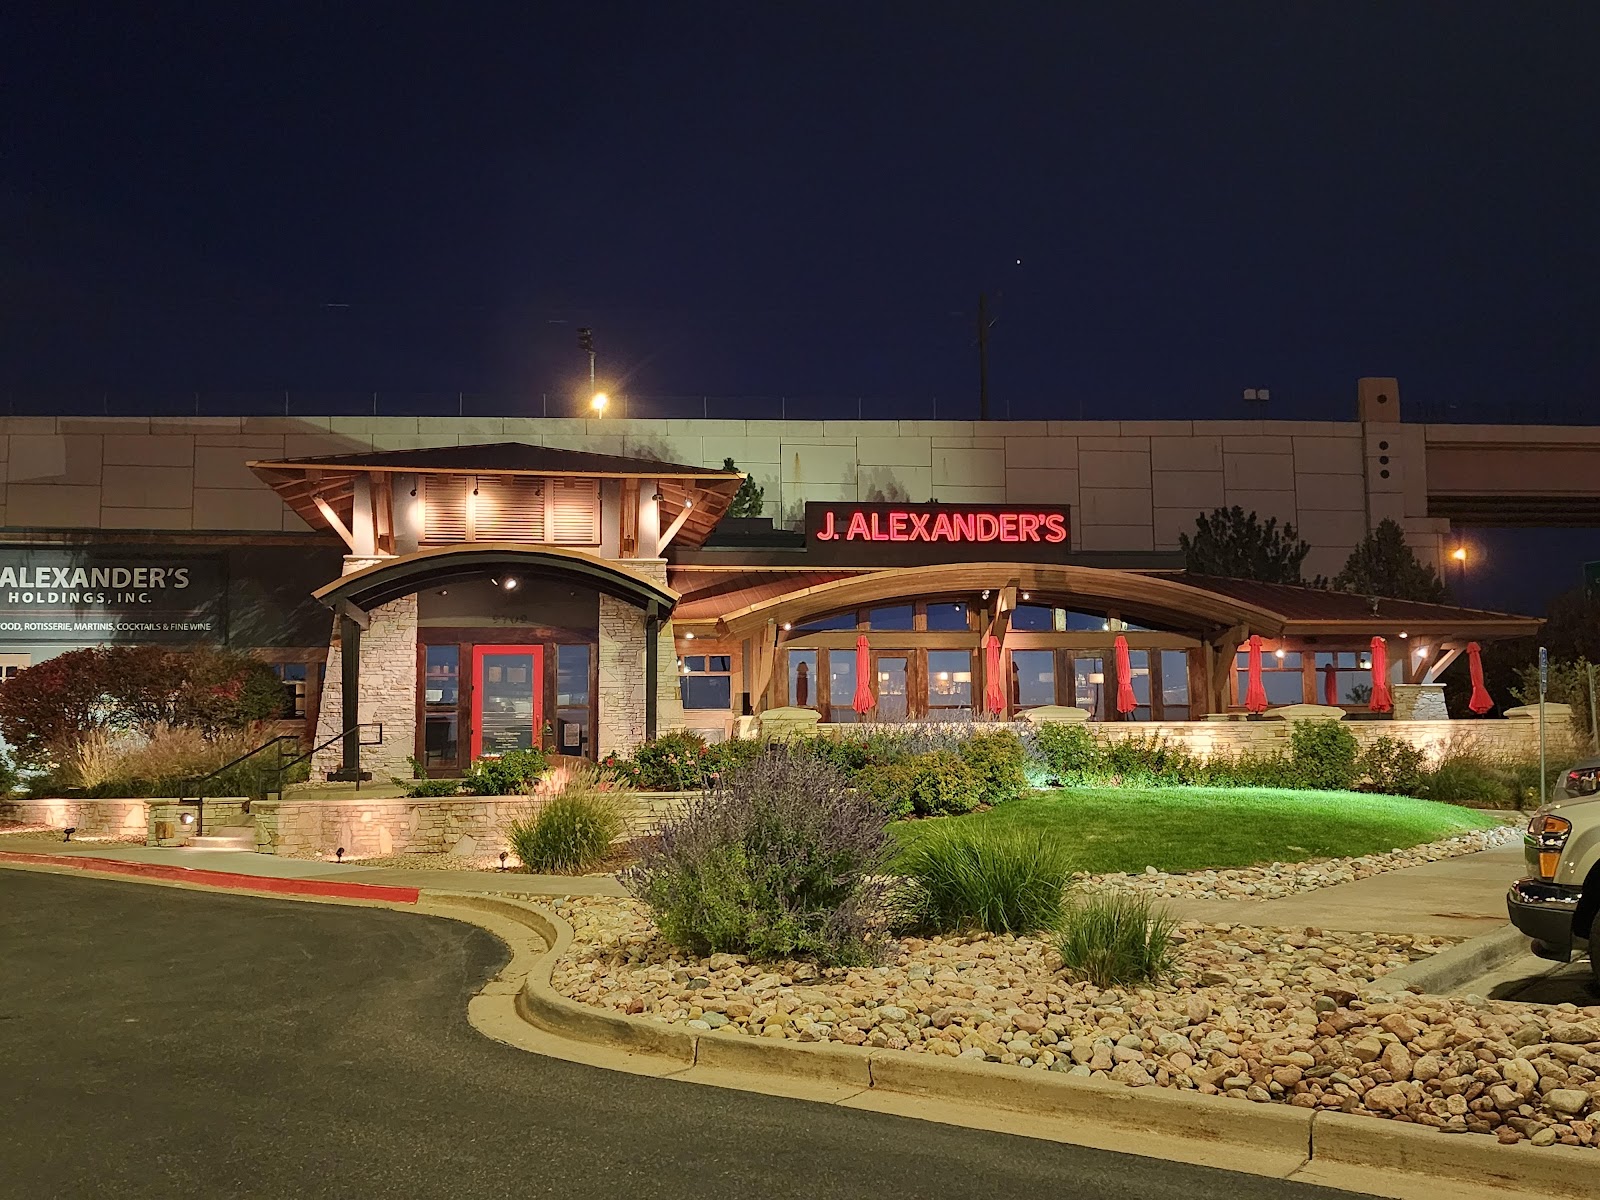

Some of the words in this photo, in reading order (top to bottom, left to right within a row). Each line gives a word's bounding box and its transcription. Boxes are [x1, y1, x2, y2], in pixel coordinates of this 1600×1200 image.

[817, 512, 839, 540] J.
[847, 512, 1067, 543] ALEXANDER'S
[0, 566, 190, 589] ALEXANDER'S
[8, 592, 111, 604] HOLDINGS,
[117, 592, 152, 603] INC.
[0, 622, 23, 631] OOD,
[24, 622, 73, 631] ROTISSERIE,
[74, 622, 115, 631] MARTINIS,
[116, 622, 160, 631] COCKTAILS
[163, 622, 169, 631] &
[170, 622, 188, 631] FINE
[190, 622, 211, 631] WINE
